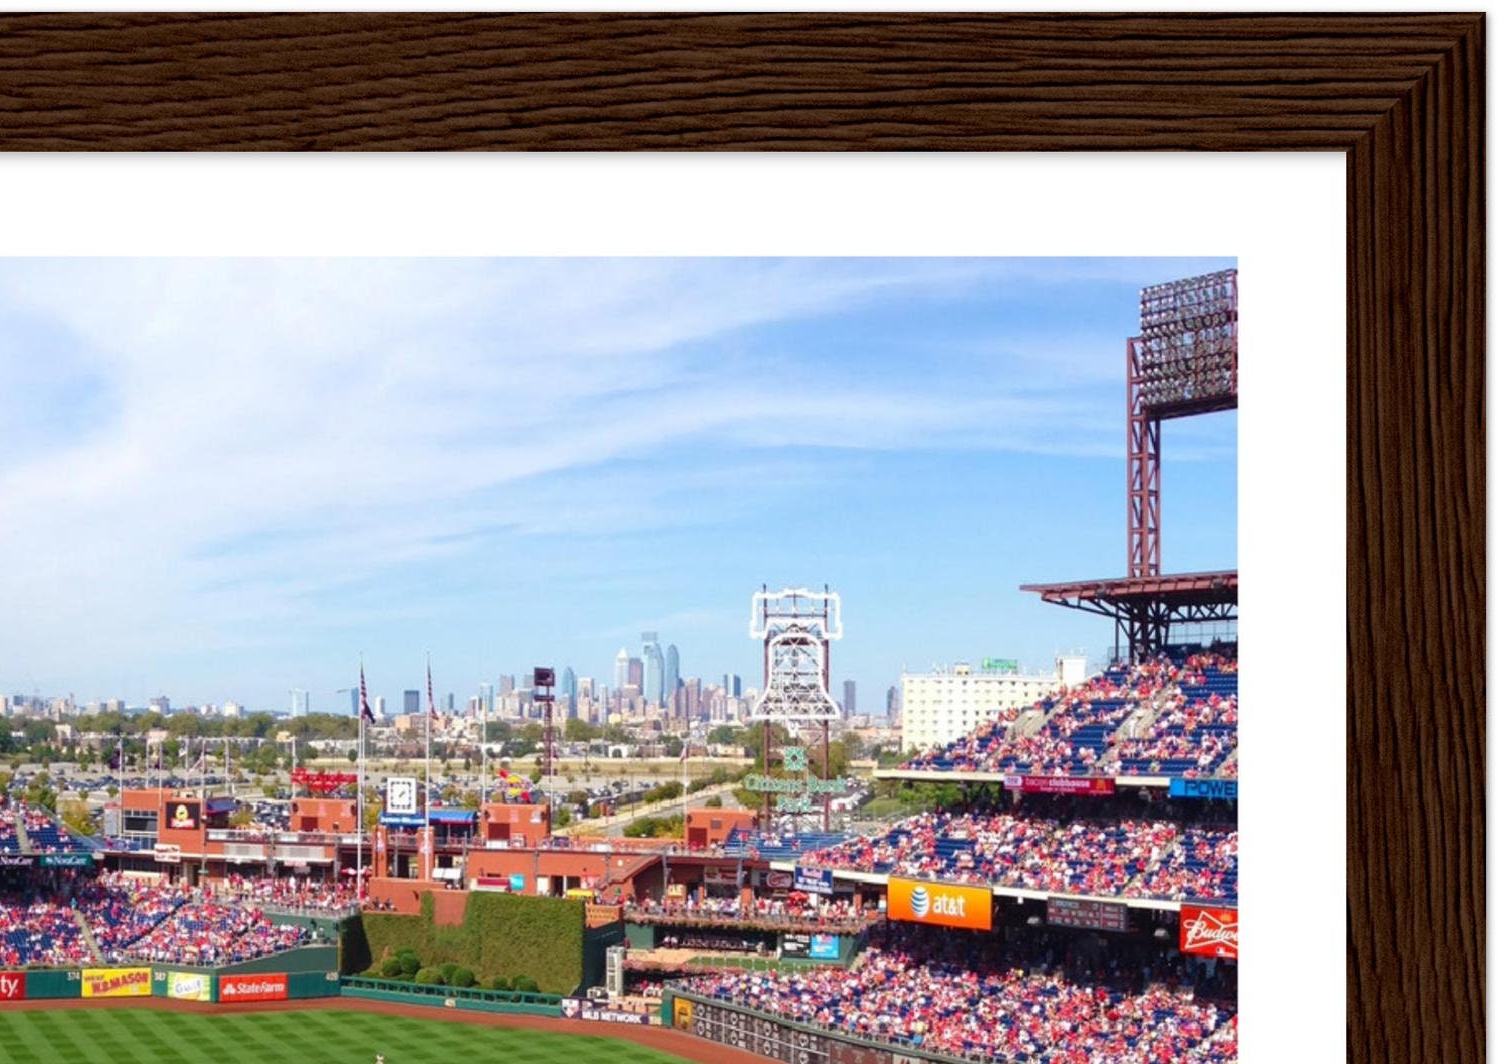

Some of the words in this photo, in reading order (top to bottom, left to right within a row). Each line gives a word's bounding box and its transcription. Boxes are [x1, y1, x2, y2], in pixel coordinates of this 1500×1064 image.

[932, 895, 966, 918] at&t
[109, 971, 149, 990] MASON
[601, 1011, 642, 1024] NETWORK
